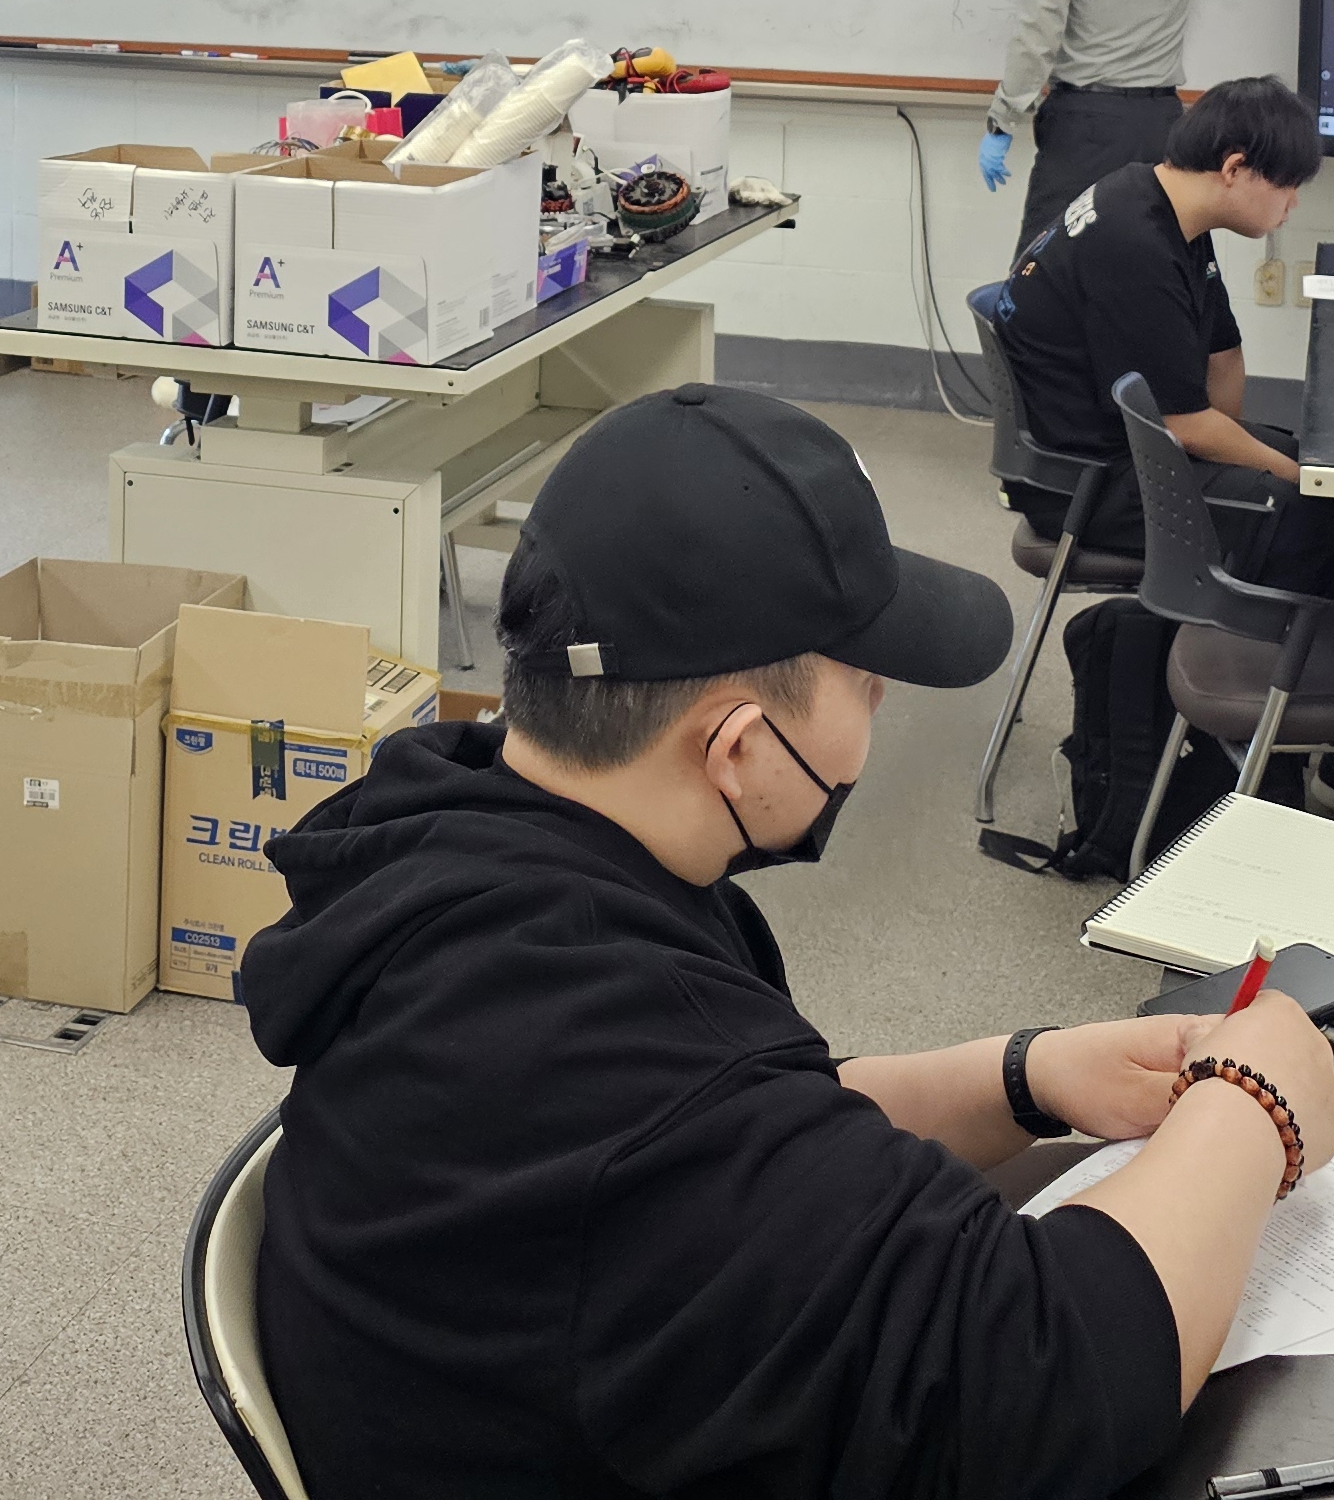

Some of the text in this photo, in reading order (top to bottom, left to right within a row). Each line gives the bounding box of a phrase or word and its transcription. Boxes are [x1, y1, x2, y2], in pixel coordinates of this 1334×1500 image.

[50, 272, 83, 283] Premium
[249, 288, 284, 300] Premium
[48, 302, 113, 317] SAMSUNG C&T
[247, 320, 315, 335] SAMSUNG C&T
[199, 852, 235, 867] CLEAN
[237, 858, 266, 872] ROLL
